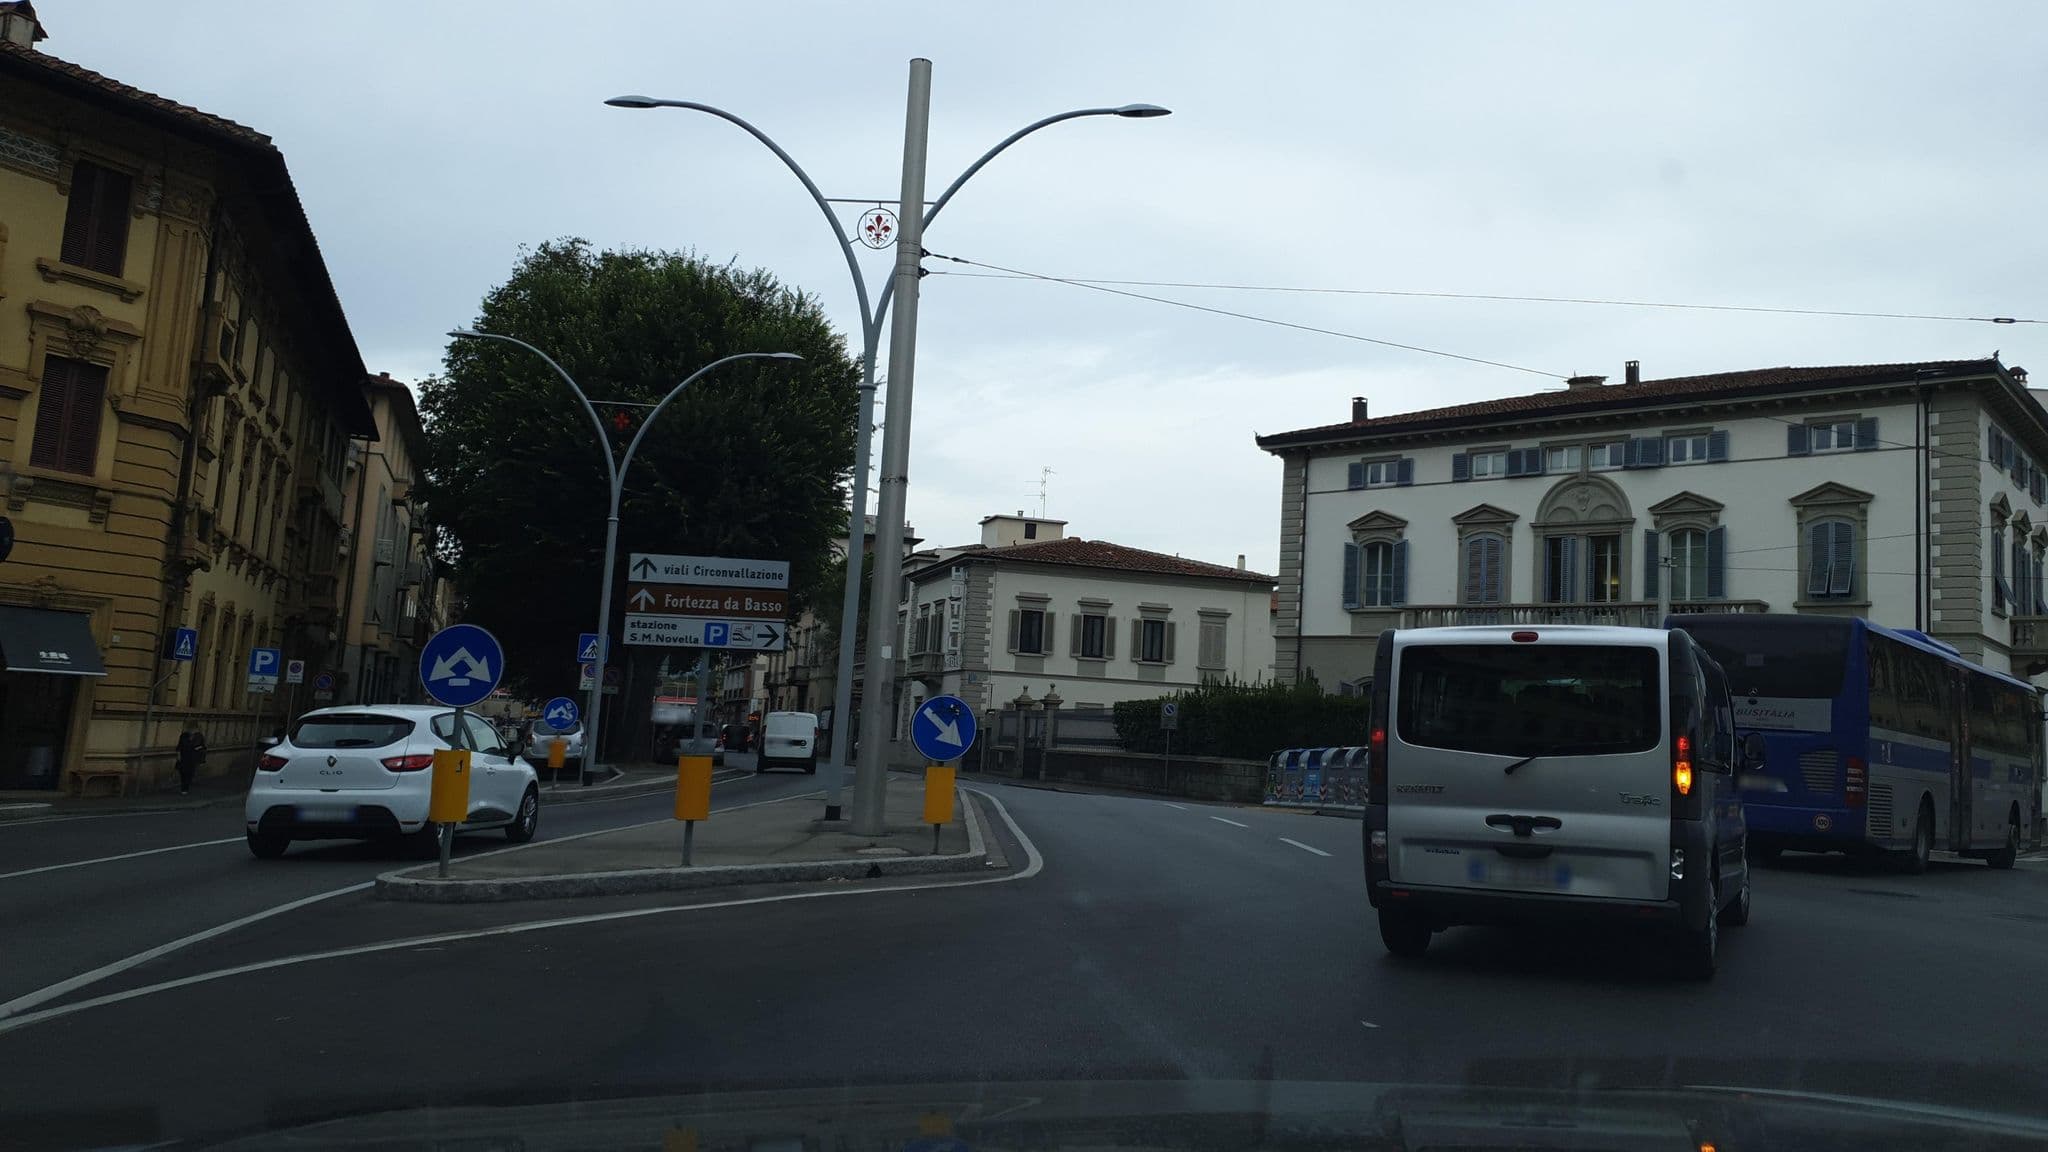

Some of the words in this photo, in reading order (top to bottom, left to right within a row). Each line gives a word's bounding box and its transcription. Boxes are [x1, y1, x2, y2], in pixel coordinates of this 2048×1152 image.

[664, 564, 689, 576] viali
[694, 565, 784, 581] Circonvallazione
[664, 593, 719, 610] Fortezza
[724, 597, 739, 610] da
[745, 597, 782, 612] Basso
[630, 619, 677, 631] stazione
[709, 626, 724, 643] P
[255, 651, 274, 672] P
